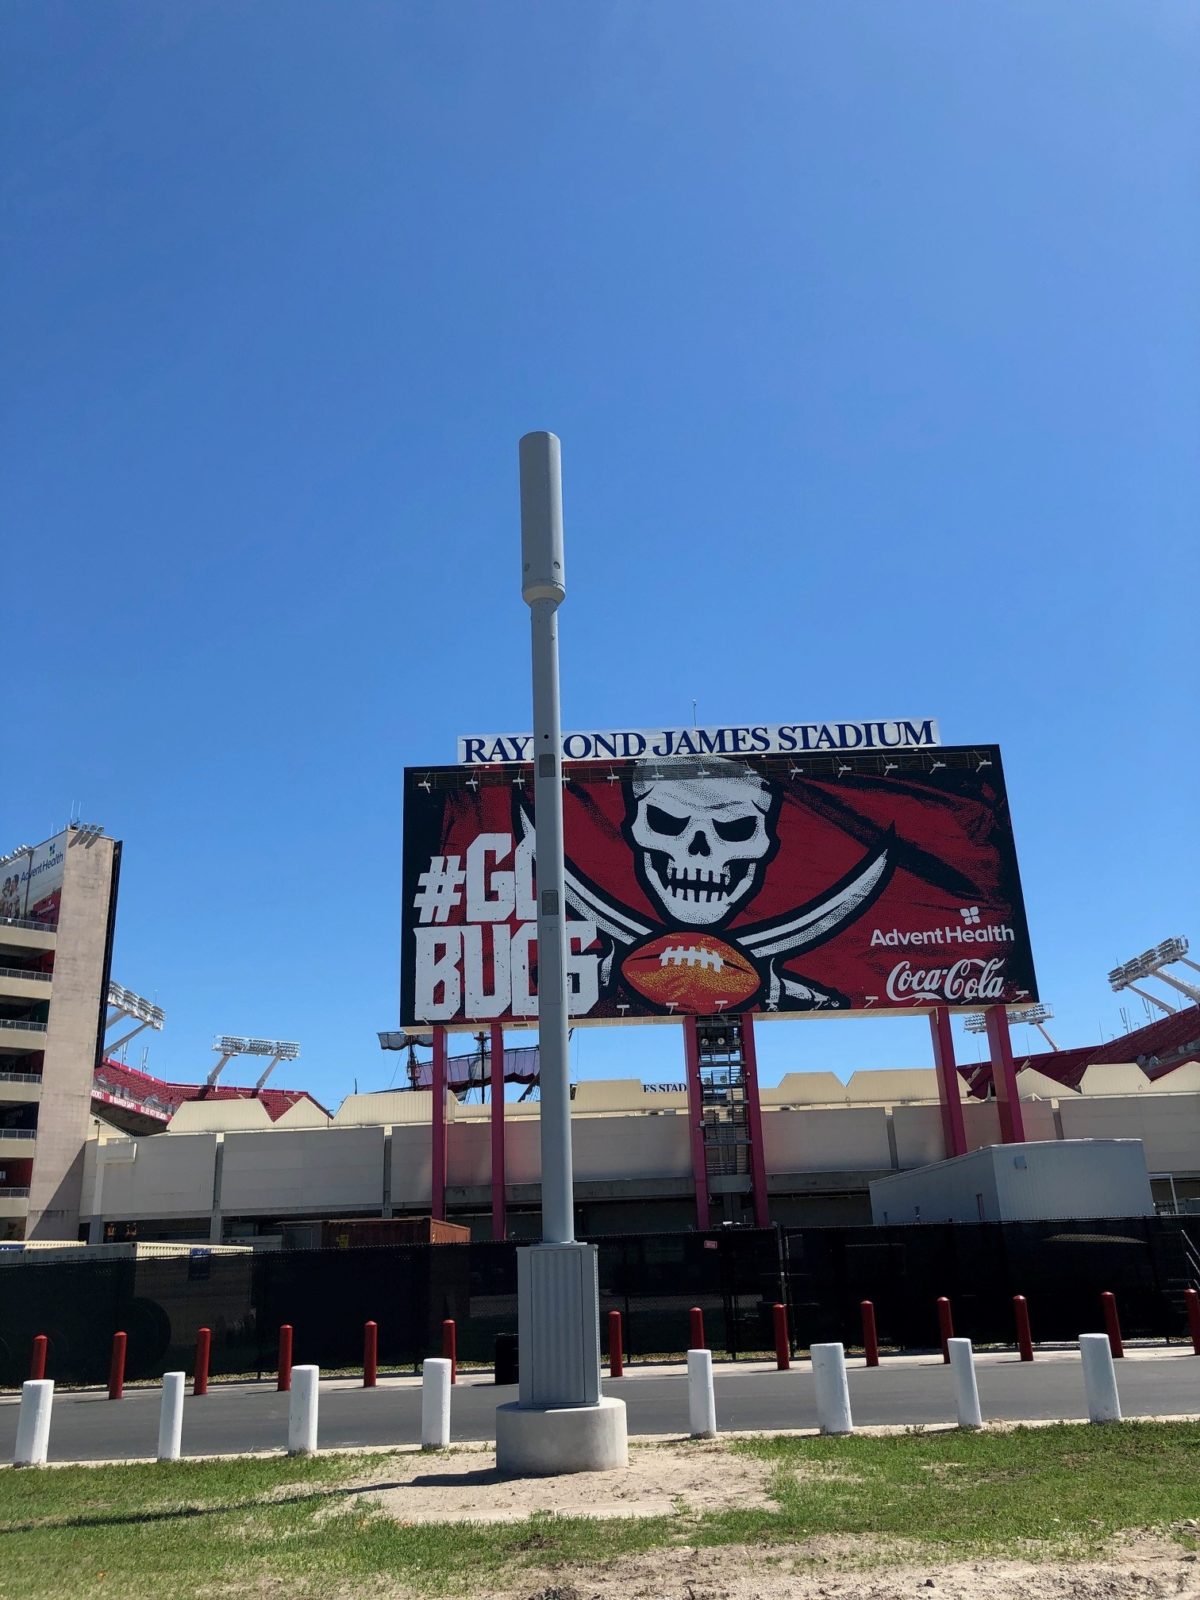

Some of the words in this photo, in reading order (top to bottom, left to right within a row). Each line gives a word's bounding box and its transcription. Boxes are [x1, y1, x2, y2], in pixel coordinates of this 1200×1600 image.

[462, 732, 647, 763] RAYOND
[653, 727, 770, 757] JAMES
[778, 720, 936, 751] STADIUM
[886, 957, 1006, 1002] Coca-Cola
